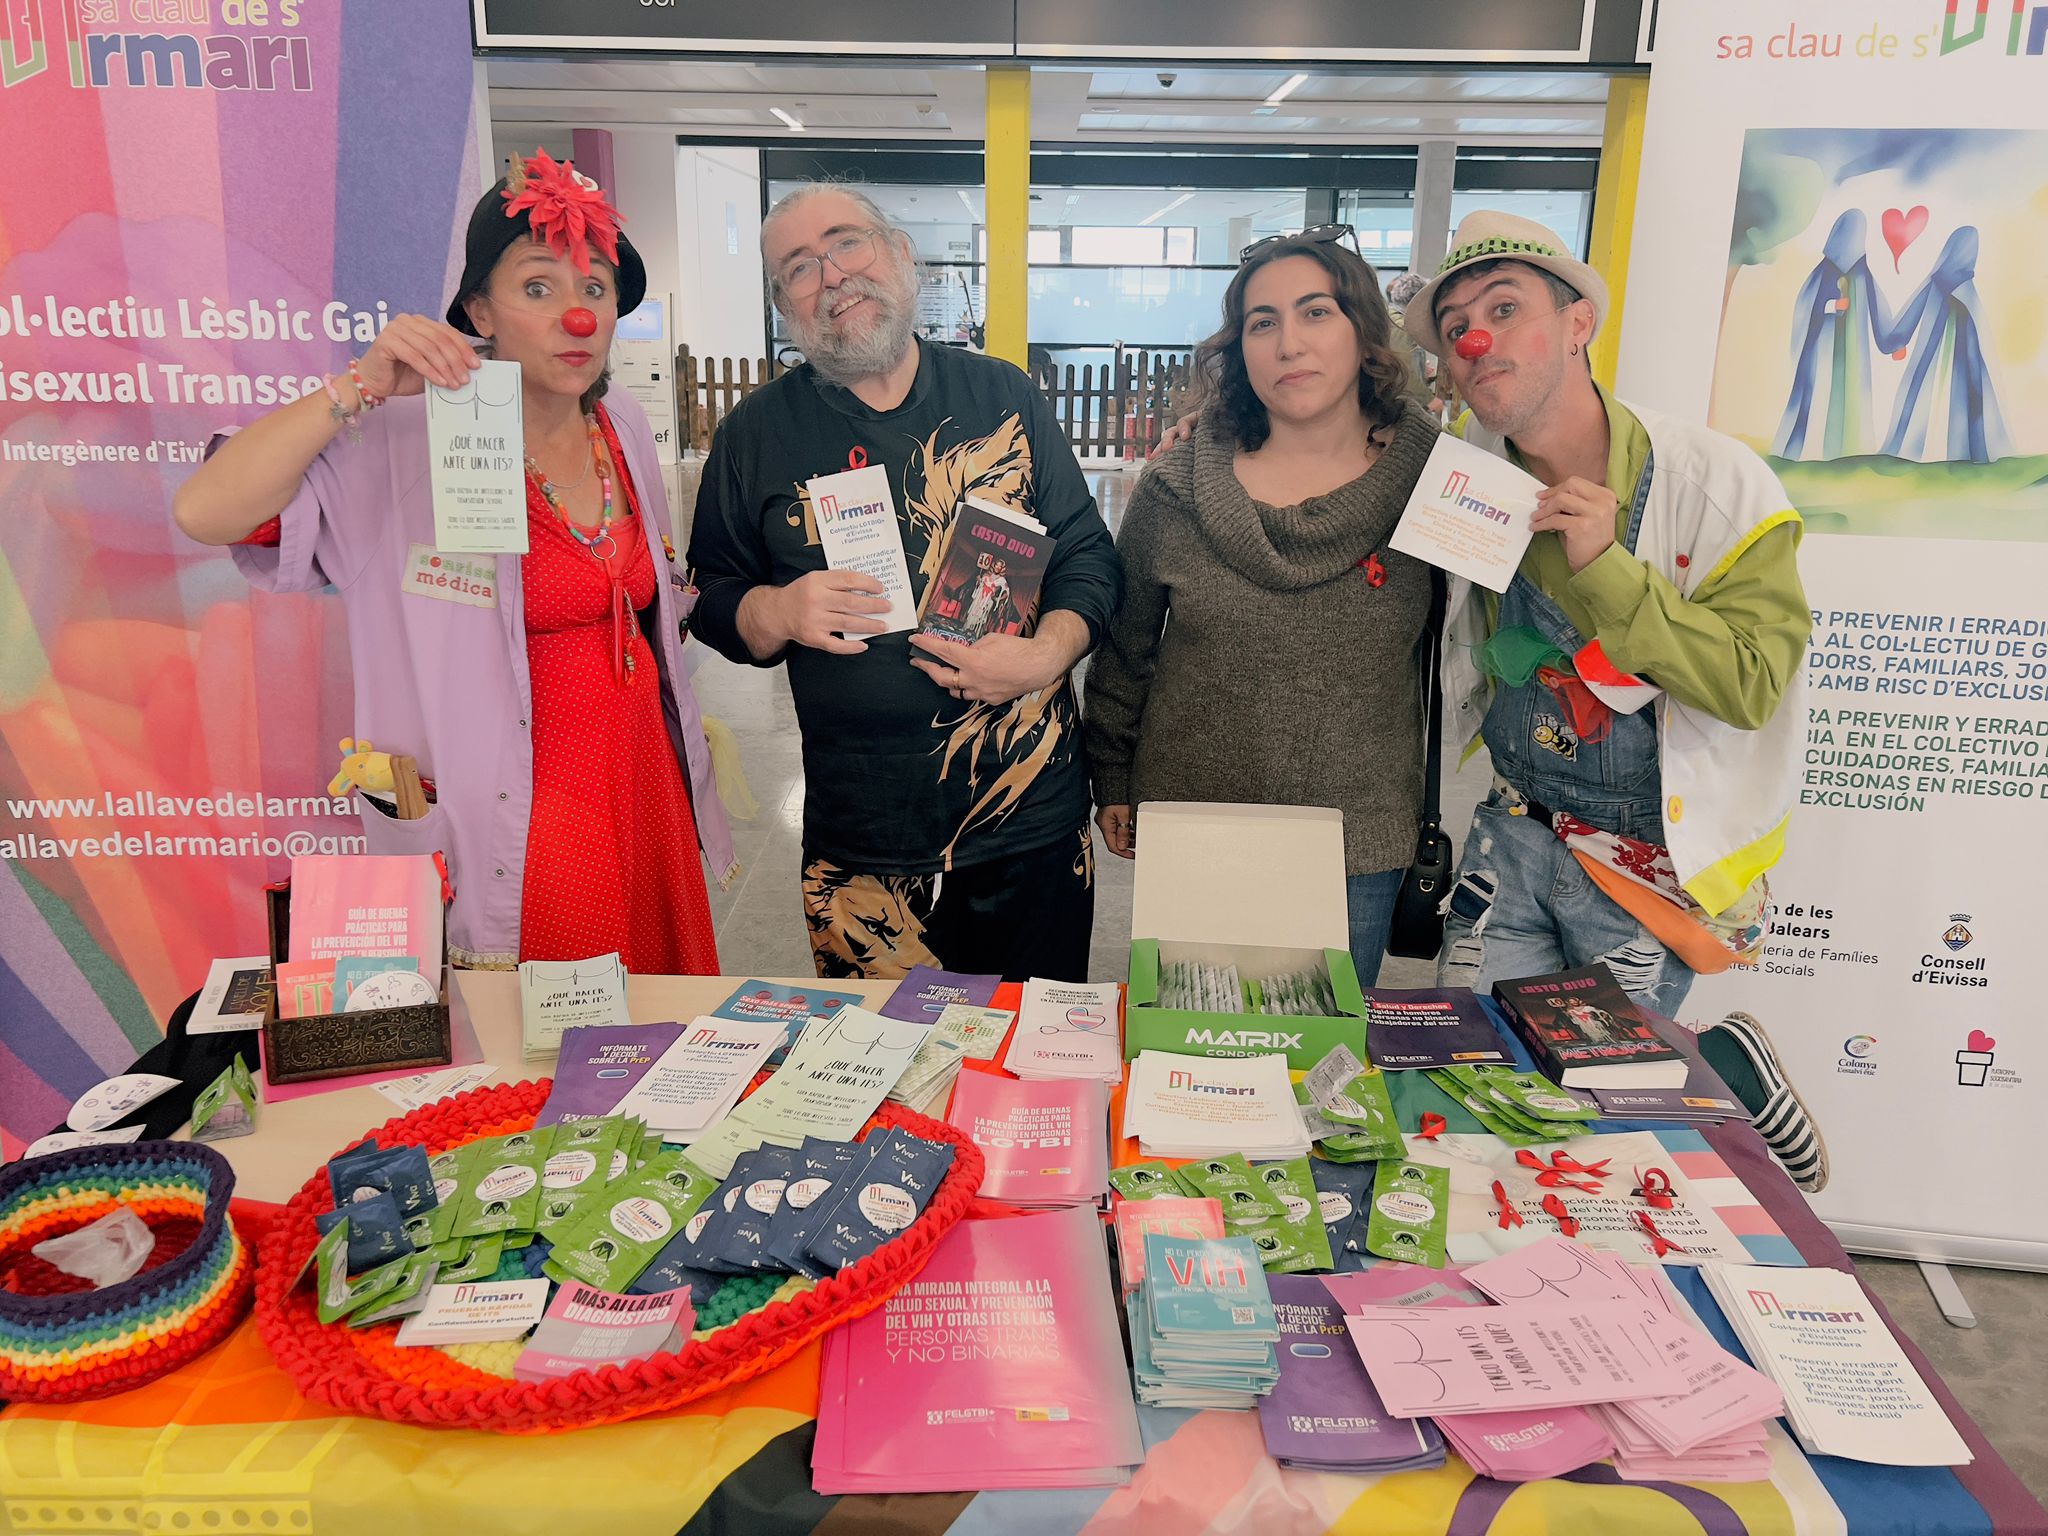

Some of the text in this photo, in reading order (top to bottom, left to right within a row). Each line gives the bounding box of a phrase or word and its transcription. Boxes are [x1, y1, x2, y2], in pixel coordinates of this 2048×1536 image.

[81, 0, 118, 23] sa
[1717, 35, 1753, 59] sa
[1767, 23, 1842, 59] clau
[1856, 23, 1898, 59] de
[177, 297, 313, 341] Lèsbic
[322, 300, 388, 342] Gai
[450, 435, 505, 453] ¿QUÉ HACER
[4, 440, 139, 467] Intergènere
[443, 456, 514, 471] ANTE UNA ITS?
[971, 524, 1036, 559] CASTO DIVO
[416, 570, 494, 598] médica
[1829, 611, 2048, 637] PREVENIR I ERRADI
[1825, 633, 1854, 649] AL
[1995, 641, 2026, 657] DE
[1884, 657, 2009, 679] FAMILIARS,
[1818, 674, 1869, 692] AMB
[1876, 678, 1928, 694] RISC
[1837, 710, 1949, 731] PREVENIR
[1956, 716, 1970, 732] Y
[1808, 729, 2039, 757] IA EN EL COLECTIVO
[1805, 749, 1955, 774] CUIDADORES,
[1802, 769, 2034, 799] ERSONAS EN RIESGO
[1800, 789, 1925, 812] EXCLUSIÓN
[1785, 904, 1833, 919] de les
[1799, 947, 1816, 959] de
[1820, 949, 1879, 964] Famílies
[1921, 954, 1986, 971] Consell
[1764, 962, 1815, 977] Socials
[1518, 977, 1598, 994] CASTO DIVO
[1912, 970, 1988, 988] d'Eivissa
[1185, 1027, 1303, 1049] MATRIX
[599, 1043, 648, 1052] INFÓRMATE
[1557, 1039, 1672, 1061] METROPOL
[588, 1057, 615, 1065] SOBRE
[629, 1056, 651, 1064] PrEP
[1838, 1058, 1877, 1071] Colonya
[808, 1070, 835, 1082] ANTE
[836, 1075, 858, 1087] UNA
[853, 1064, 885, 1077] HACER
[1008, 1114, 1050, 1123] PRÁCTICAS
[1011, 1107, 1028, 1115] GUÍA
[974, 1125, 980, 1133] Y
[981, 1127, 1004, 1138] OTRAS
[1031, 1129, 1071, 1139] PERSONAS
[975, 1116, 985, 1126] LA
[987, 1120, 1039, 1131] PREVENCIÓN
[1057, 1121, 1071, 1129] VIH
[973, 1133, 1071, 1149] LGTBI
[1570, 1206, 1694, 1217] del VIH ITS
[1601, 1198, 1635, 1207] de la
[1536, 1217, 1701, 1227] las en el
[1164, 1255, 1247, 1286] VIH
[914, 1281, 962, 1295] MIRADA
[965, 1280, 1023, 1294] INTEGRAL
[1026, 1279, 1033, 1293] A
[1036, 1279, 1051, 1293] LA
[572, 1287, 674, 1312] MÁS ALLÁ DEL
[885, 1294, 1053, 1313] SALUD SEXUAL Y PREVENCIÓN
[563, 1302, 669, 1326] DIAGNÓSTICO
[885, 1311, 1056, 1329] DEL VIH Y OTRAS ITS EN LAS
[1278, 1315, 1324, 1326] Y DECIDE
[886, 1327, 1058, 1346] PERSONAS TRANS
[1304, 1325, 1345, 1335] LA PrEP
[886, 1343, 1061, 1364] Y NO BINARIAS
[1455, 1325, 1514, 1392] TENGO UNA ITS
[1501, 1347, 1536, 1375] AHORA
[1313, 1417, 1378, 1428] FELGTBI+
